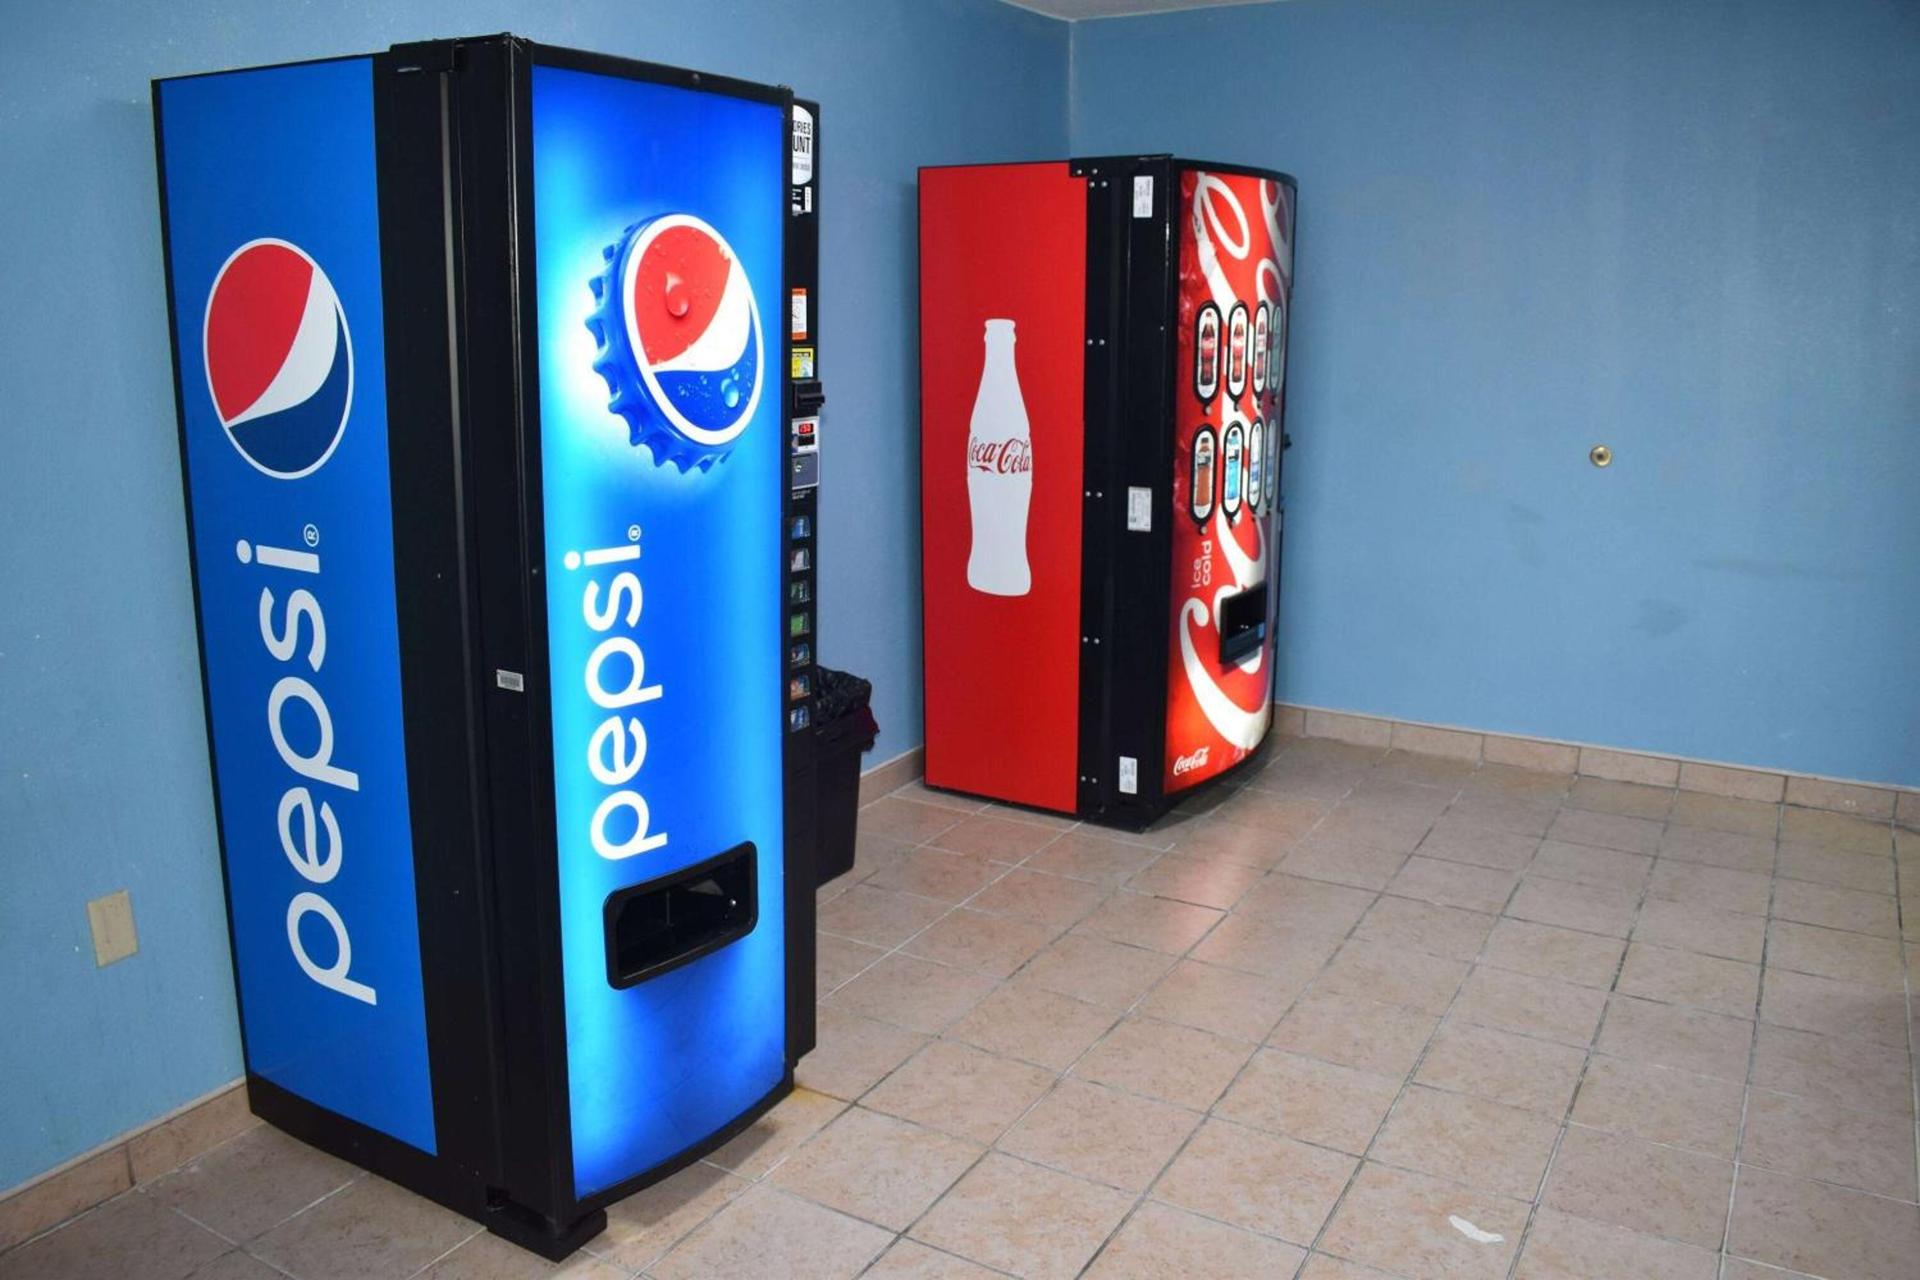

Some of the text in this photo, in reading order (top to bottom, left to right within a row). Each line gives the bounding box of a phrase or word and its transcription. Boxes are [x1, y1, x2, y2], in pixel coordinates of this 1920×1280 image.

[969, 436, 1029, 475] Coca-Cola
[1191, 557, 1201, 588] ice
[1201, 540, 1212, 586] cold
